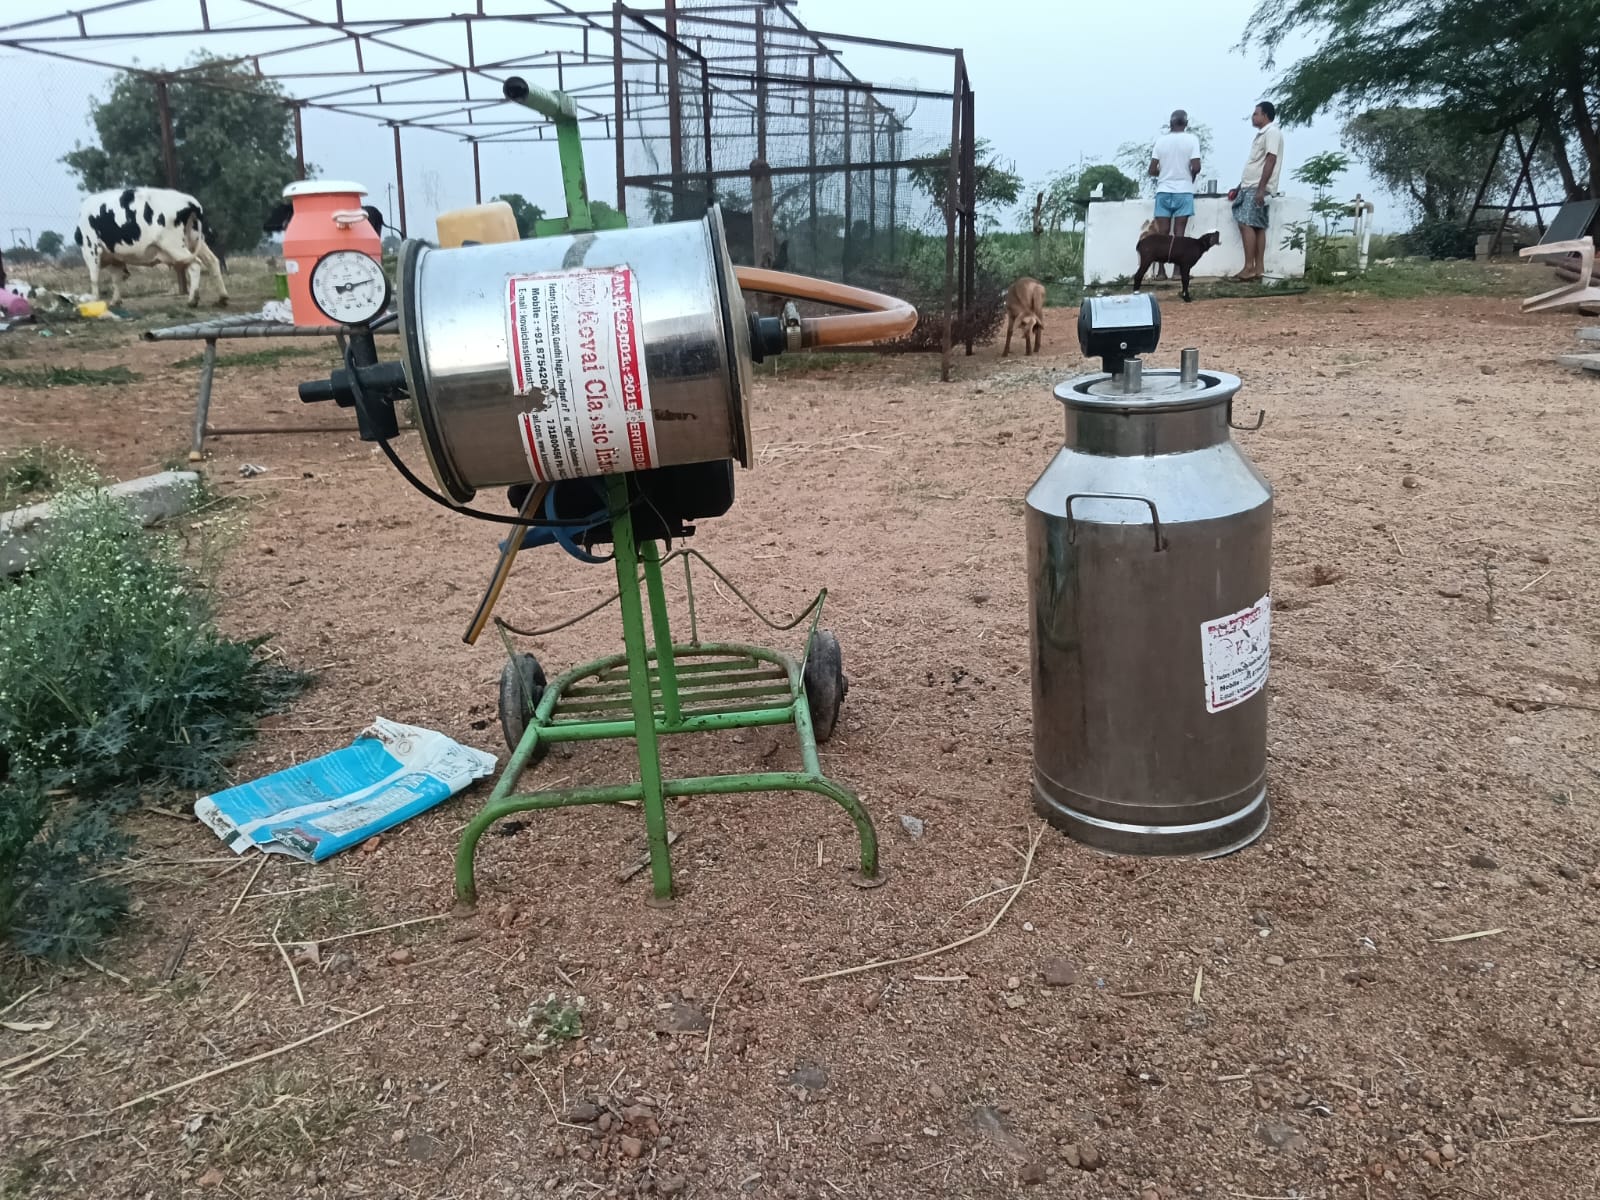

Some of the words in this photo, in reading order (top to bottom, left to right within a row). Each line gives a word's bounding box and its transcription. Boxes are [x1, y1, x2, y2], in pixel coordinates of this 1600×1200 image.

[518, 288, 527, 310] E-mail
[531, 288, 541, 318] Mobile
[534, 326, 544, 345] +91
[552, 337, 563, 358] Gandhi
[578, 311, 605, 372] Kovai
[623, 373, 637, 410] 2015
